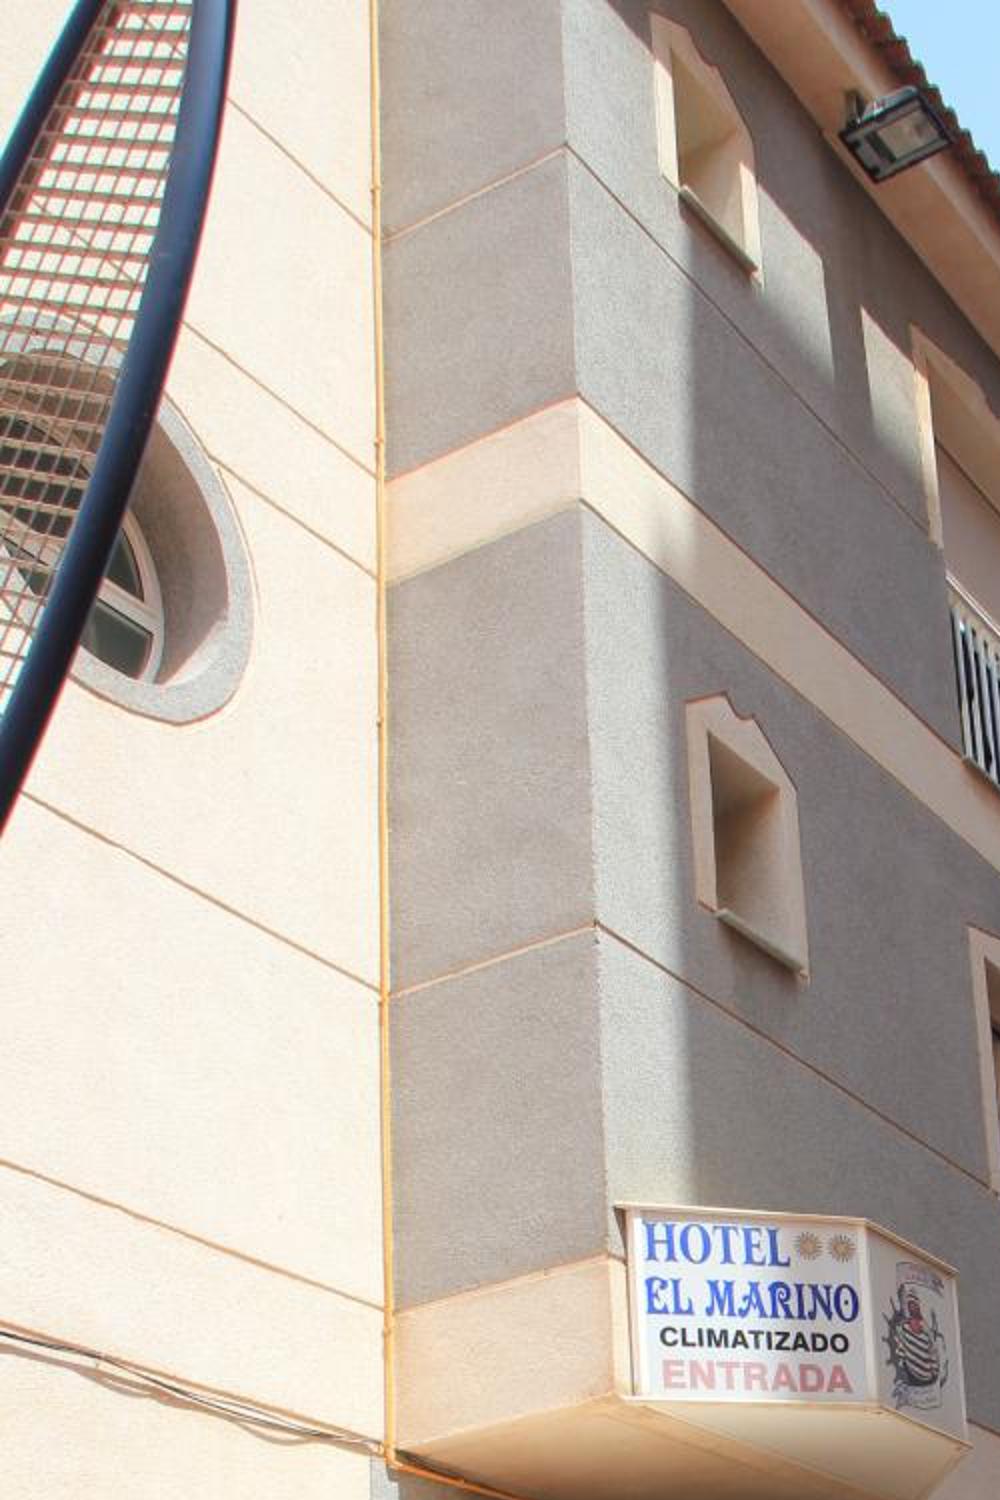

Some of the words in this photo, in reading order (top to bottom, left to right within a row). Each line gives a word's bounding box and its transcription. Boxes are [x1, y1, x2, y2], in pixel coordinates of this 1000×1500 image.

[642, 1219, 791, 1267] HOTEL
[645, 1276, 694, 1315] EL
[705, 1279, 860, 1323] MARINO
[660, 1327, 850, 1354] CLIMATIZADO
[662, 1359, 854, 1394] ENTRADA
